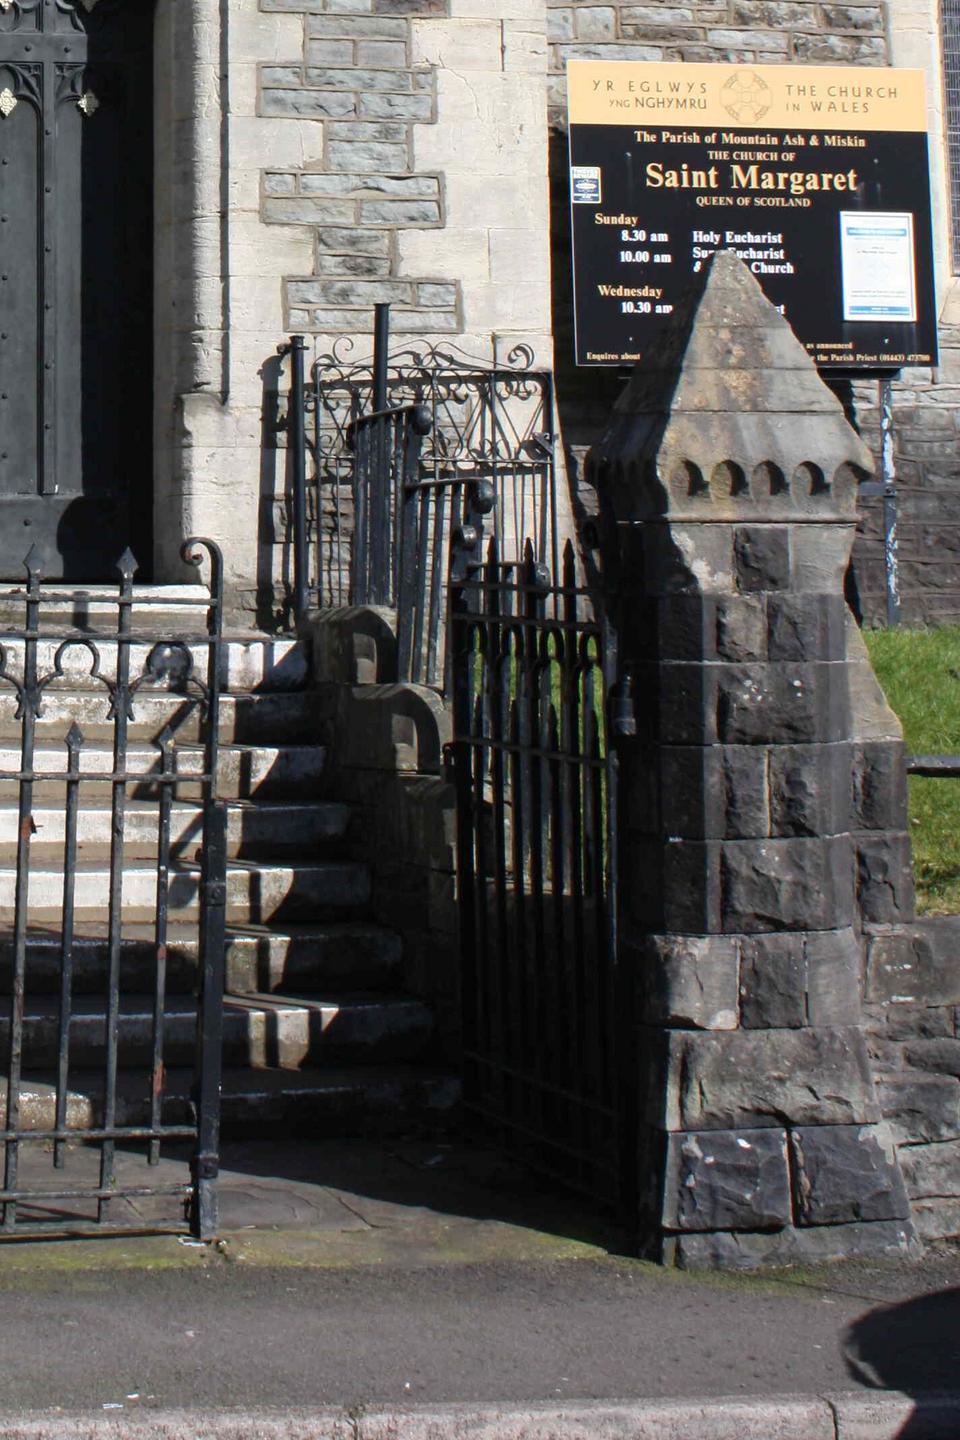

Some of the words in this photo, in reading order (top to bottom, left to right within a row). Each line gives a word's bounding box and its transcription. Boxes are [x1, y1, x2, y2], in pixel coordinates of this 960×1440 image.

[593, 80, 614, 91] YR
[628, 81, 707, 93] EGLWYS
[785, 85, 817, 96] THE
[827, 86, 898, 98] CHURCH
[609, 99, 631, 108] YNG
[634, 97, 708, 109] NGHYMRU
[785, 103, 801, 111] IN
[810, 101, 870, 113] WALES
[634, 131, 657, 143] The
[661, 131, 700, 144] Parish
[704, 132, 717, 144] of
[721, 133, 779, 145] Mountain
[783, 135, 805, 146] Ash
[809, 135, 820, 146] &
[824, 135, 867, 148] Miskin
[707, 150, 730, 160] THE
[732, 151, 778, 161] CHURCH
[781, 152, 797, 162] OF
[645, 162, 719, 188] Saint
[730, 163, 859, 195] Margaret
[696, 196, 734, 207] QUEEN
[736, 197, 751, 207] OF
[754, 197, 812, 208] SCOTLAND
[594, 213, 639, 227] Sunday
[621, 229, 647, 242] 8.30
[650, 232, 669, 242] am
[692, 230, 721, 245] Holy
[725, 231, 783, 244] Eucharist
[619, 250, 650, 263] 10.00
[653, 253, 672, 263] am
[751, 261, 794, 274] Church
[597, 285, 663, 299] Wednesday
[621, 301, 651, 314] 10.30
[655, 303, 674, 314] am
[816, 342, 853, 350] announced
[586, 351, 619, 362] Enquires
[621, 351, 641, 360] about
[817, 353, 829, 361] the
[830, 353, 854, 362] Parish
[856, 354, 878, 362] Priest
